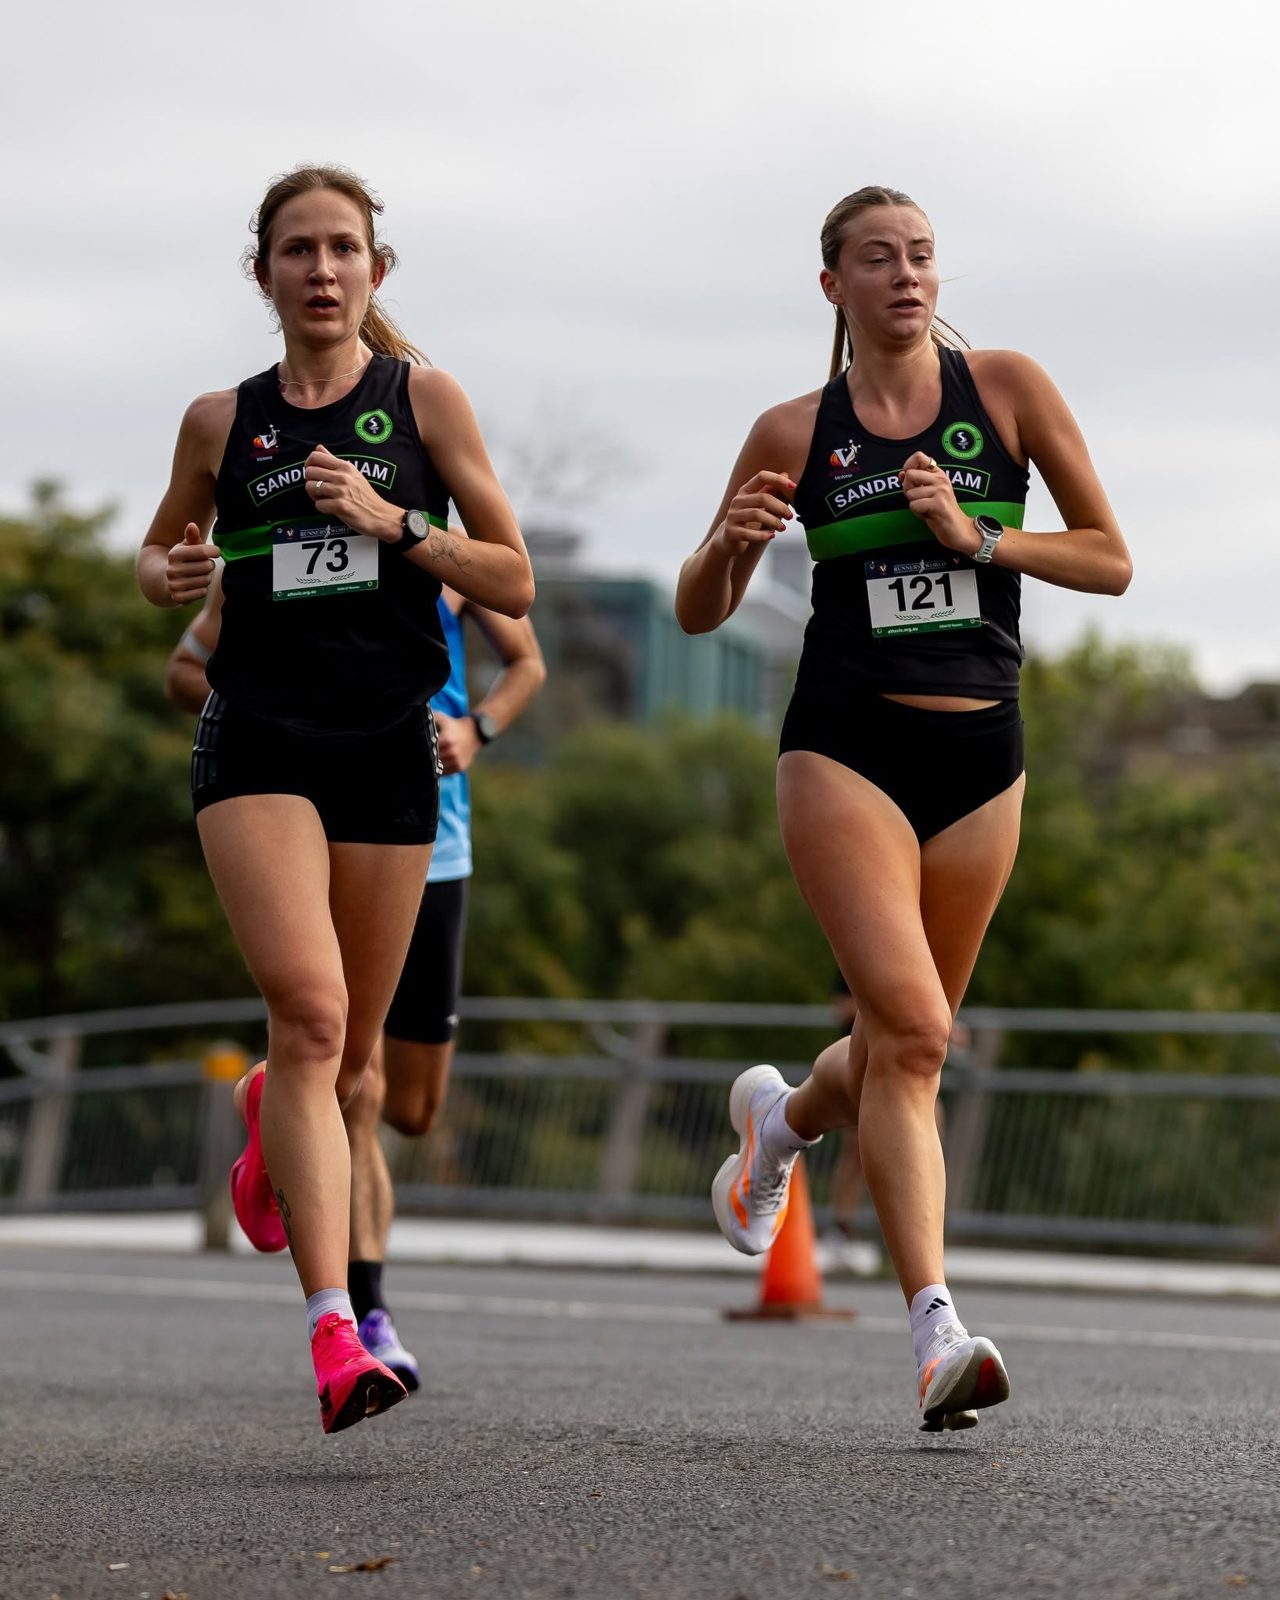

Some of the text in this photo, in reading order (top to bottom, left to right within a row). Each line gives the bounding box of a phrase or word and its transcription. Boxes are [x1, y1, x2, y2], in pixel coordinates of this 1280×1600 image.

[256, 460, 389, 497] SANDAM
[834, 469, 982, 508] SANDRAM
[302, 539, 349, 575] 73
[888, 573, 953, 612] 121
